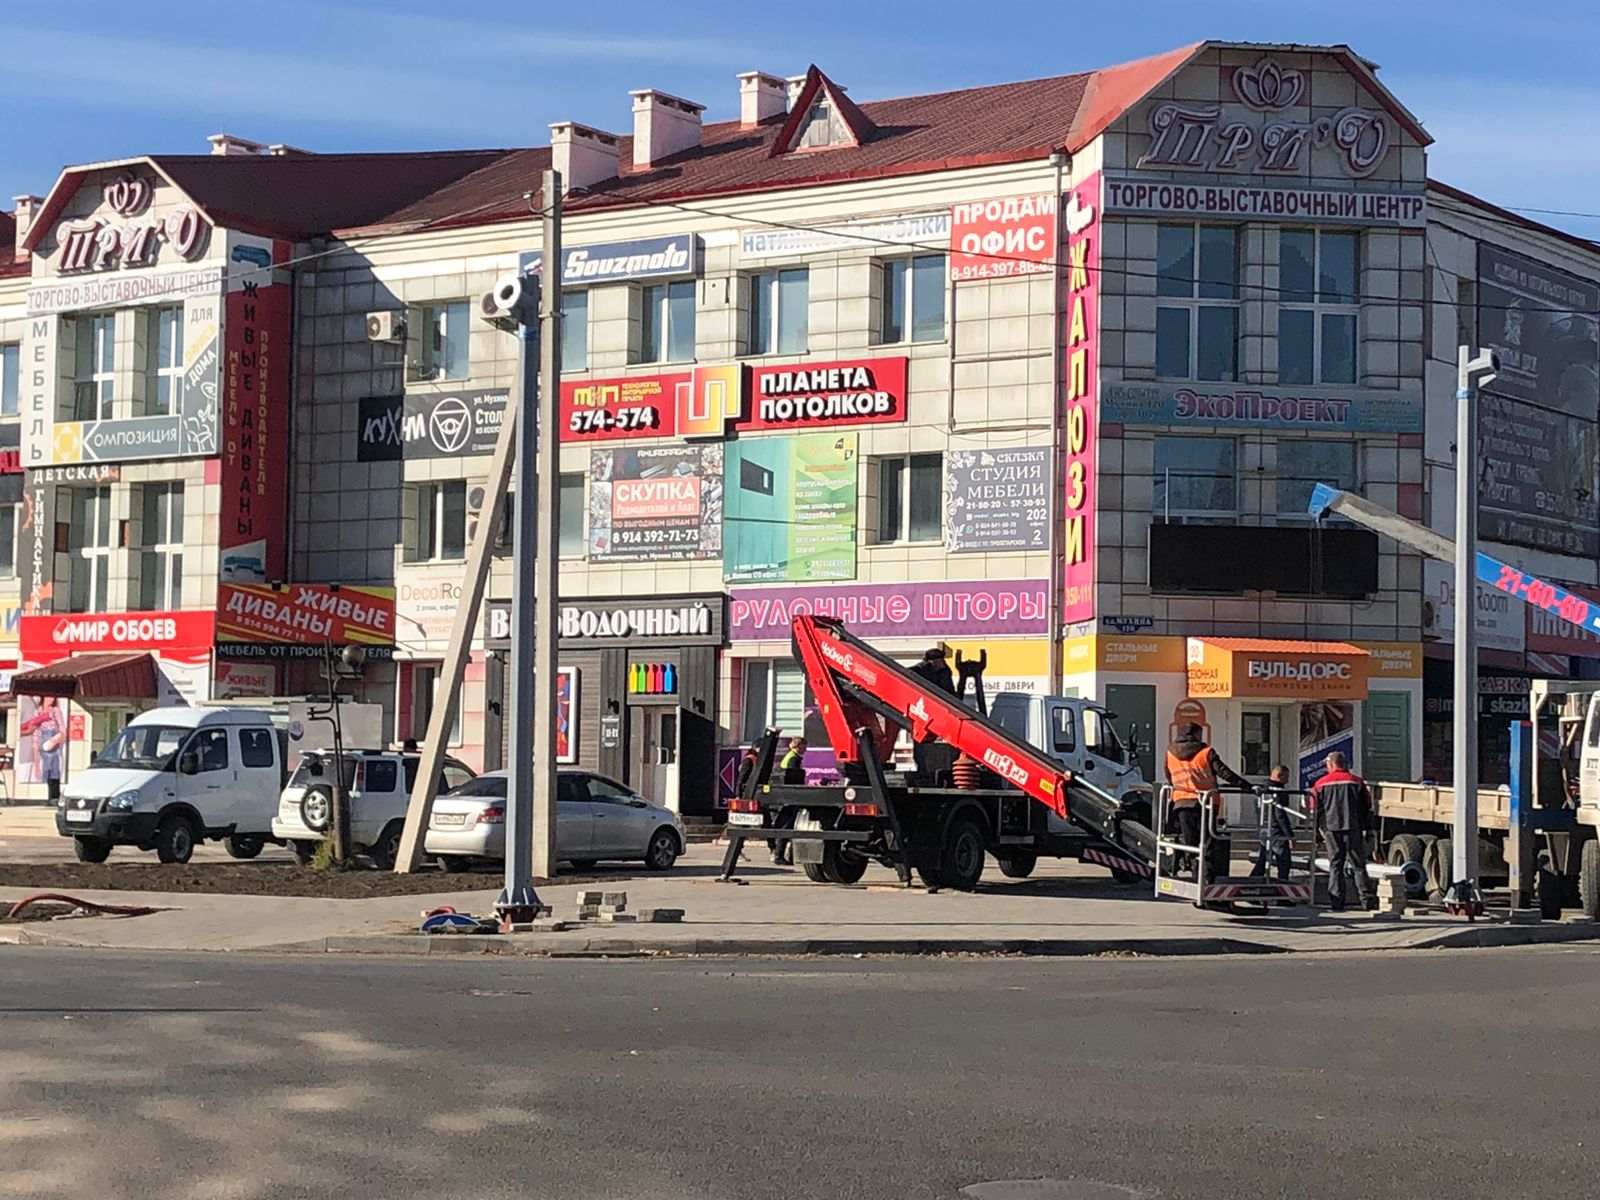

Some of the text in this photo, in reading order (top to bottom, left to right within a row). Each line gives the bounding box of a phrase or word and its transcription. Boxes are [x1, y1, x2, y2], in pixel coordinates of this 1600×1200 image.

[954, 196, 1054, 225] ПРОДАМ
[1109, 183, 1423, 220] ТОРГОВО-ВЫСТАВОЧНЫЙ ЦЕНТР
[961, 226, 1045, 257] ОФИС
[564, 243, 688, 278] Souzmoto
[28, 270, 220, 312] ТОРГОВО-ВЫСТАВОЧНЫЙ ЦЕНТР
[191, 307, 213, 324] ДЛЯ
[189, 350, 216, 387] ДОМА
[760, 366, 870, 395] ПЛАНЕТА
[30, 321, 49, 462] МЕБЕЛЬ
[1065, 238, 1088, 565] ЖАЛЮЗИ
[227, 351, 239, 467] МЕБЕЛЬ ОТ
[236, 280, 258, 536] ЖИВЫЕ ДИВАНЫ
[257, 331, 269, 496] ПРОИЗВОДИТЕЛЯ
[476, 409, 503, 425] Стол
[569, 406, 654, 431] 574-574
[760, 392, 889, 420] ПОТОЛКОВ
[996, 451, 1045, 463] СКАЗКА
[33, 466, 110, 485] ДЕТСКАЯ
[970, 465, 1041, 482] СТУДИЯ
[616, 480, 697, 502] СКУПКА
[967, 483, 1044, 499] МЕБЕЛИ
[1026, 508, 1047, 520] 202
[612, 529, 699, 543] 8 914 392-71-73
[1033, 530, 1041, 541] 2
[32, 489, 45, 609] ГИМНАСТИКА
[225, 591, 332, 637] ДИВАНЫ
[295, 587, 389, 629] ЖИВЫЕ
[733, 592, 1046, 627] РУЛОННЫЕ ШТОРЫ
[70, 619, 176, 642] МИР ОБОЕВ
[218, 645, 266, 657] МЕБЕЛЬ
[270, 646, 286, 657] ОТ
[1105, 643, 1158, 652] СТАЛЬНЫЕ
[1105, 654, 1137, 663] ДВЕРИ
[1248, 661, 1352, 681] БУЛЬДОРС
[1004, 681, 1035, 691] ДВЕРИ
